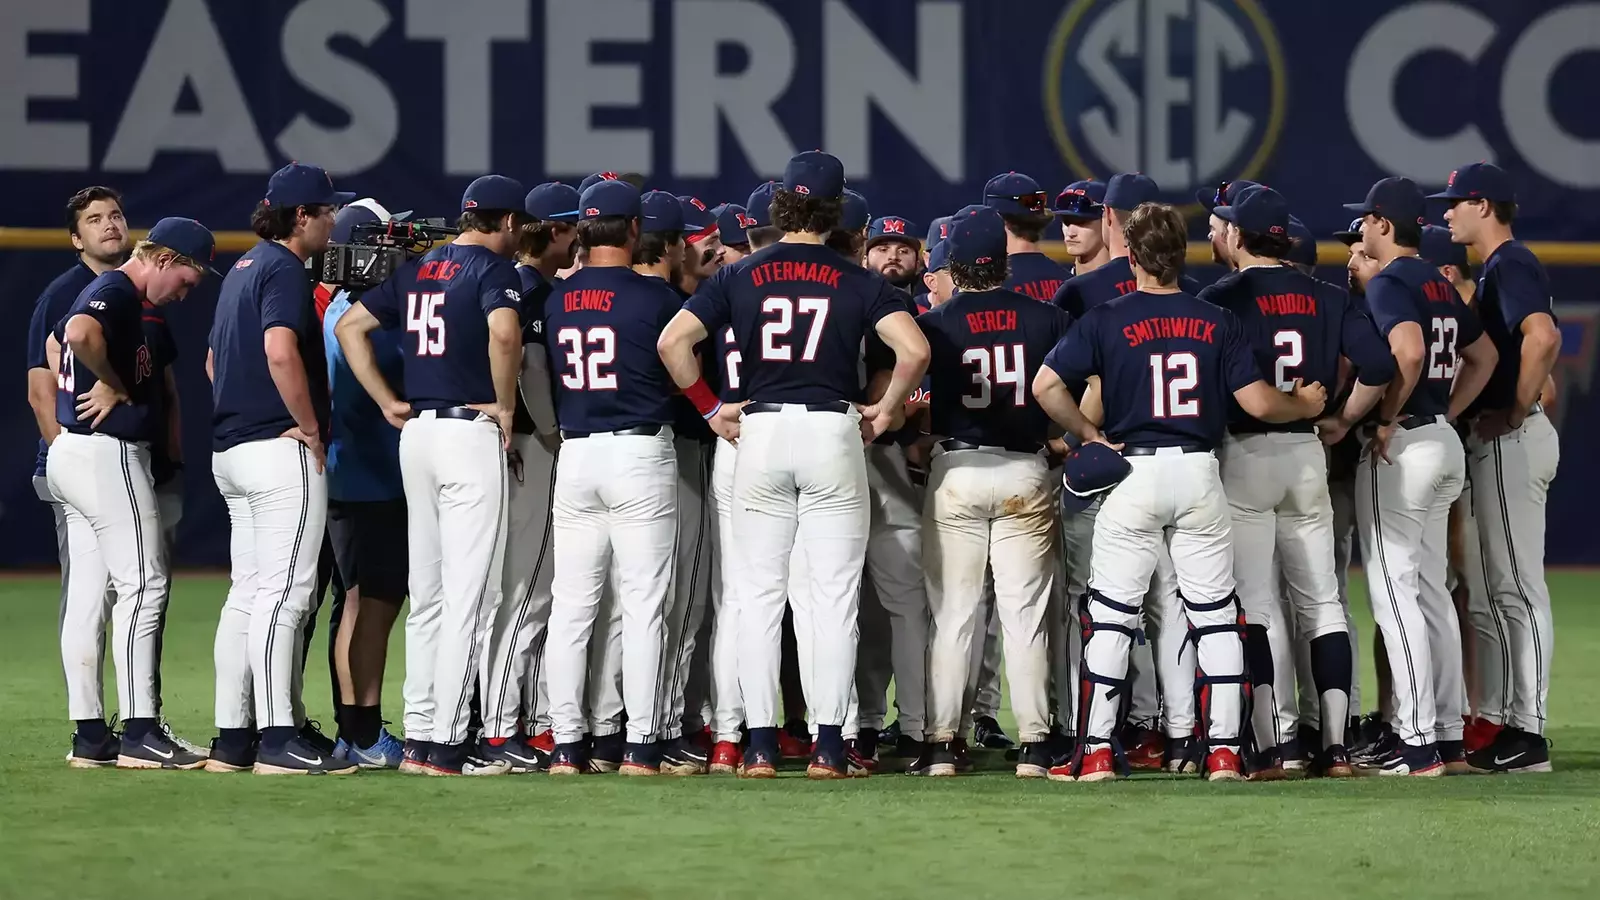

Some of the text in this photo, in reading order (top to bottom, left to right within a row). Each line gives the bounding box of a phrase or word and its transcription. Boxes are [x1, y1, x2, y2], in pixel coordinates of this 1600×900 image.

[0, 0, 965, 183] EASTERN
[1077, 0, 1254, 190] SEC
[882, 219, 905, 235] M
[564, 289, 615, 313] DENNIS
[751, 261, 843, 289] UTERMARK
[1256, 293, 1316, 316] MADDOX
[407, 291, 445, 356] 45
[760, 295, 830, 362] 27
[1122, 317, 1216, 348] SMITHWICK
[1427, 316, 1459, 379] 23
[557, 326, 618, 391] 32
[960, 343, 1025, 409] 34
[1149, 351, 1199, 418] 12
[1273, 329, 1303, 392] 2
